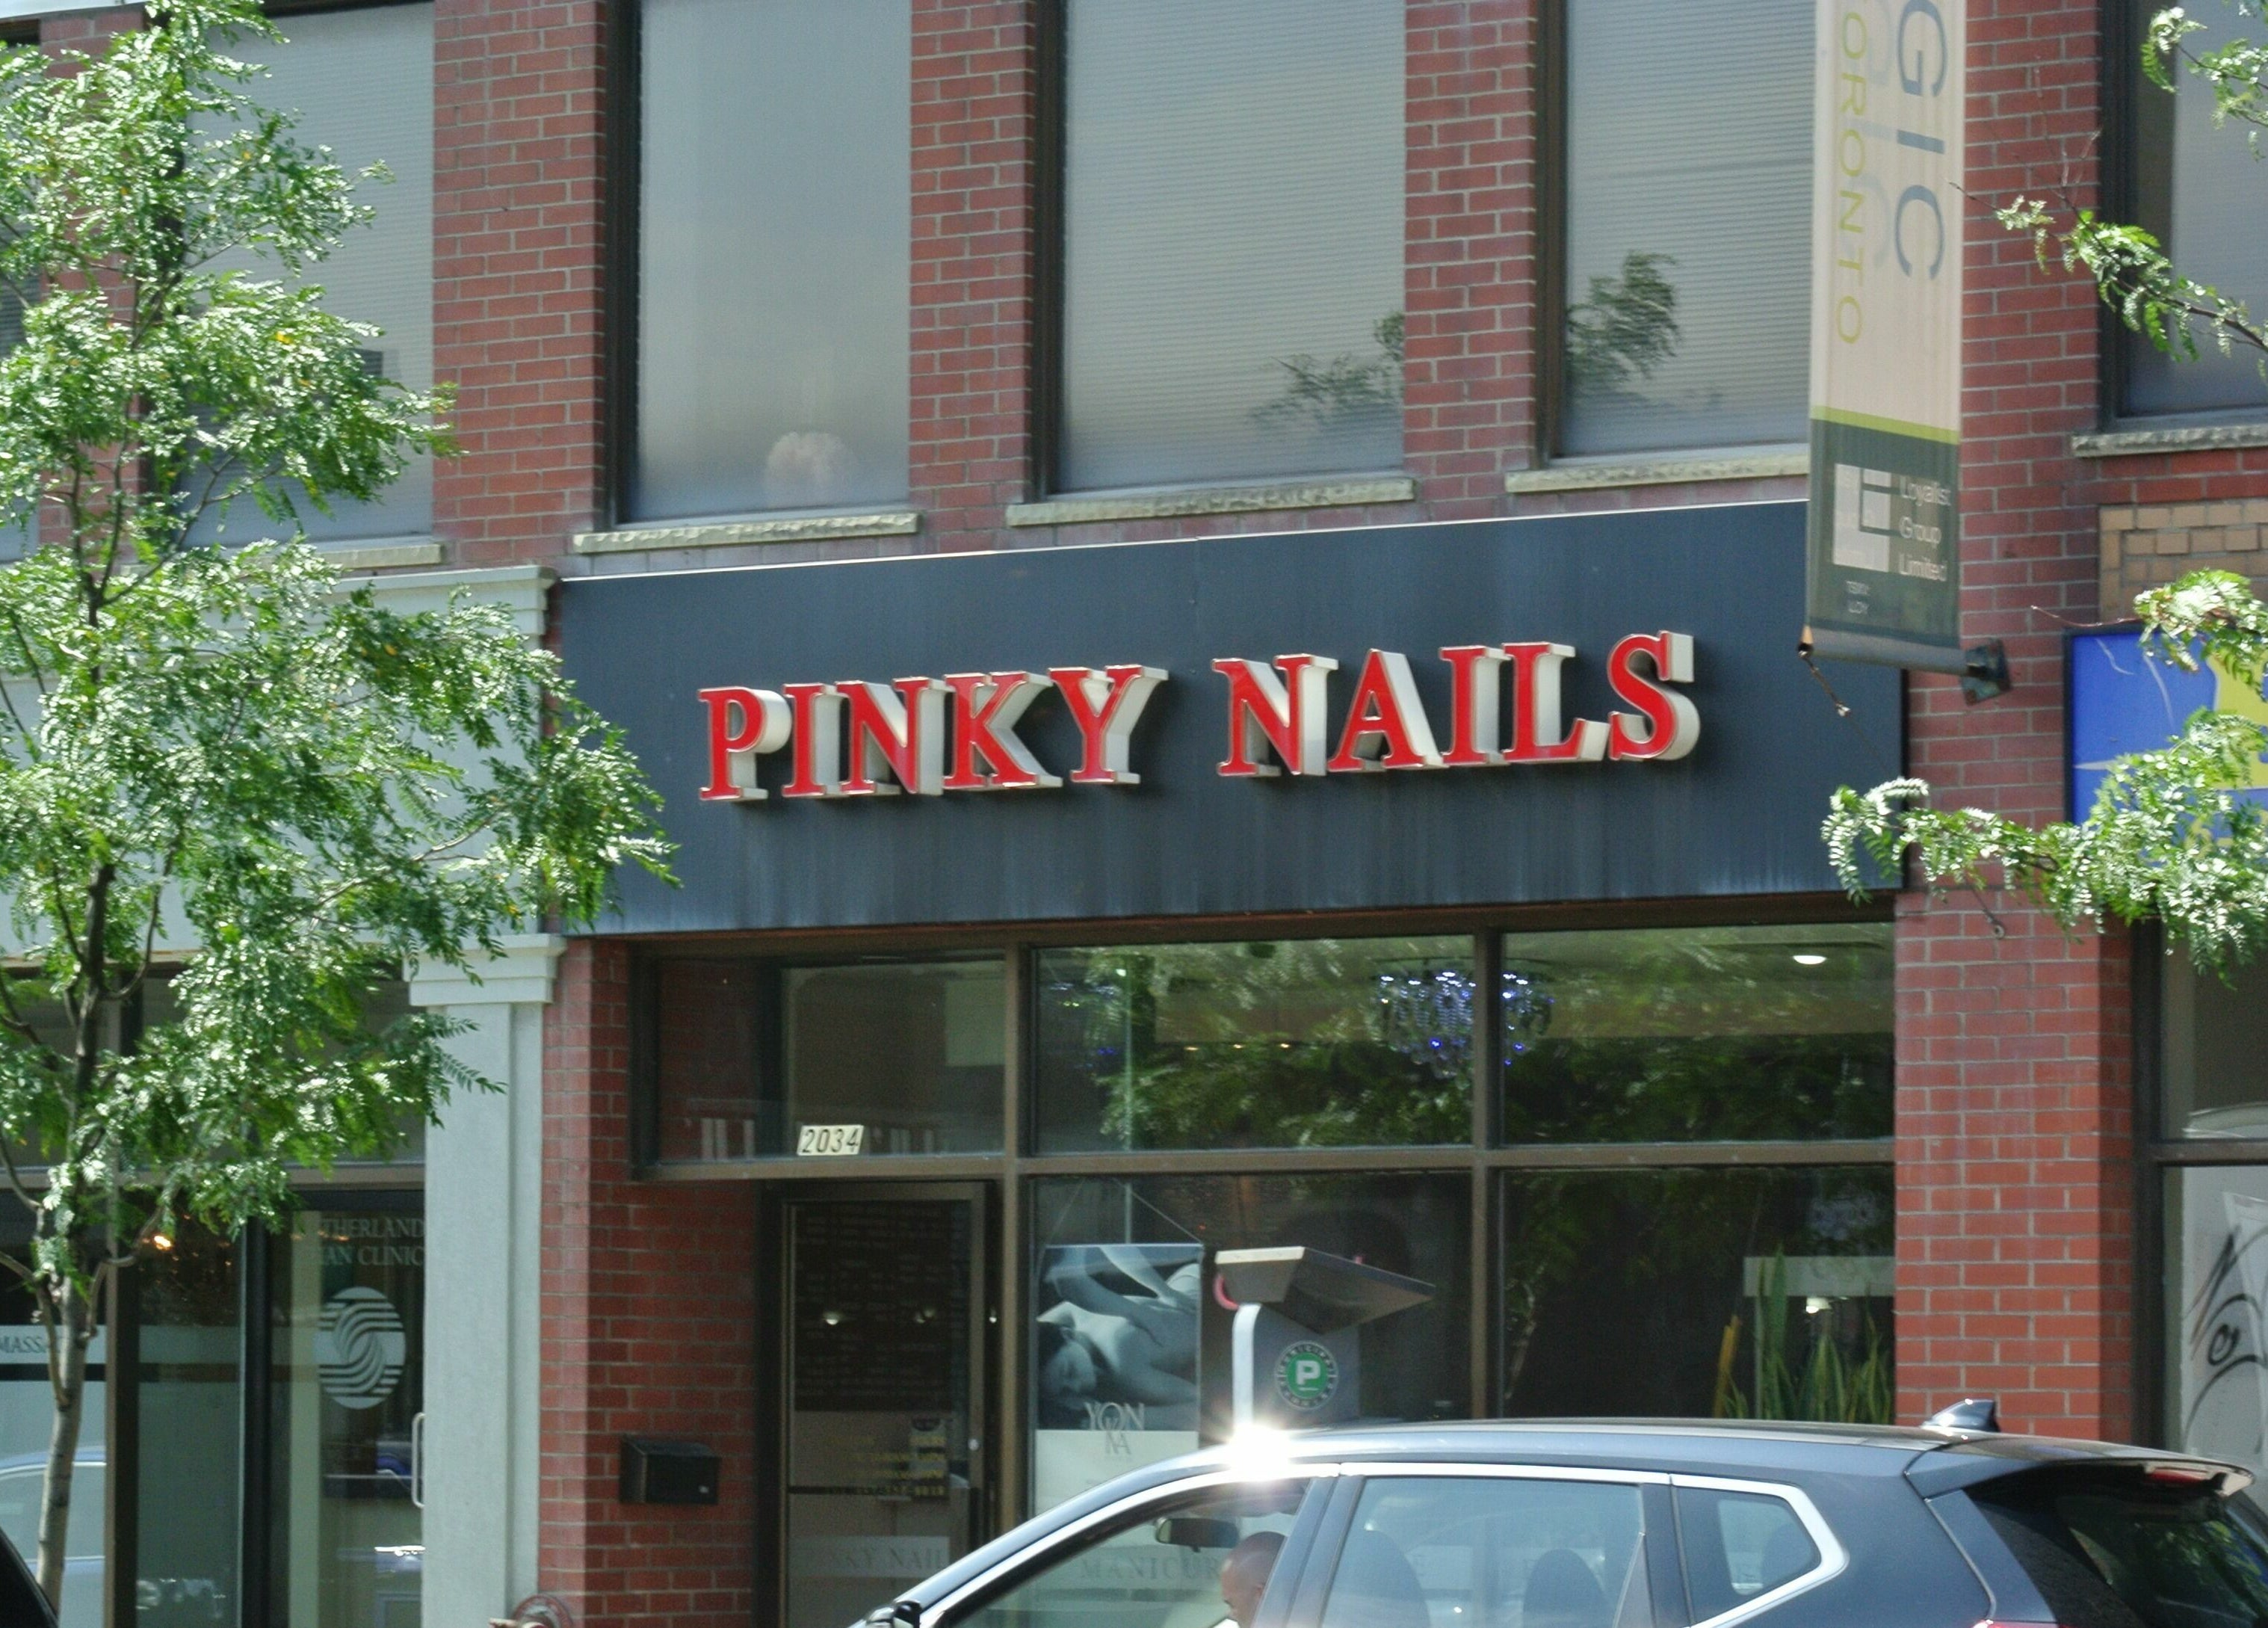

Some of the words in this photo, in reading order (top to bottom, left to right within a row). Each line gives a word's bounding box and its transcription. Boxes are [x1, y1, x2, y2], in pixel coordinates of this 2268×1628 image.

[1836, 0, 1868, 344] ORONTO
[1899, 516, 1942, 549] Group
[1898, 552, 1947, 582] Limited
[698, 664, 1169, 801] PINKY
[1211, 630, 1701, 777] NAILS
[801, 1127, 860, 1153] 2034
[1296, 1360, 1321, 1385] P
[1081, 1555, 1221, 1579] MANICUR
